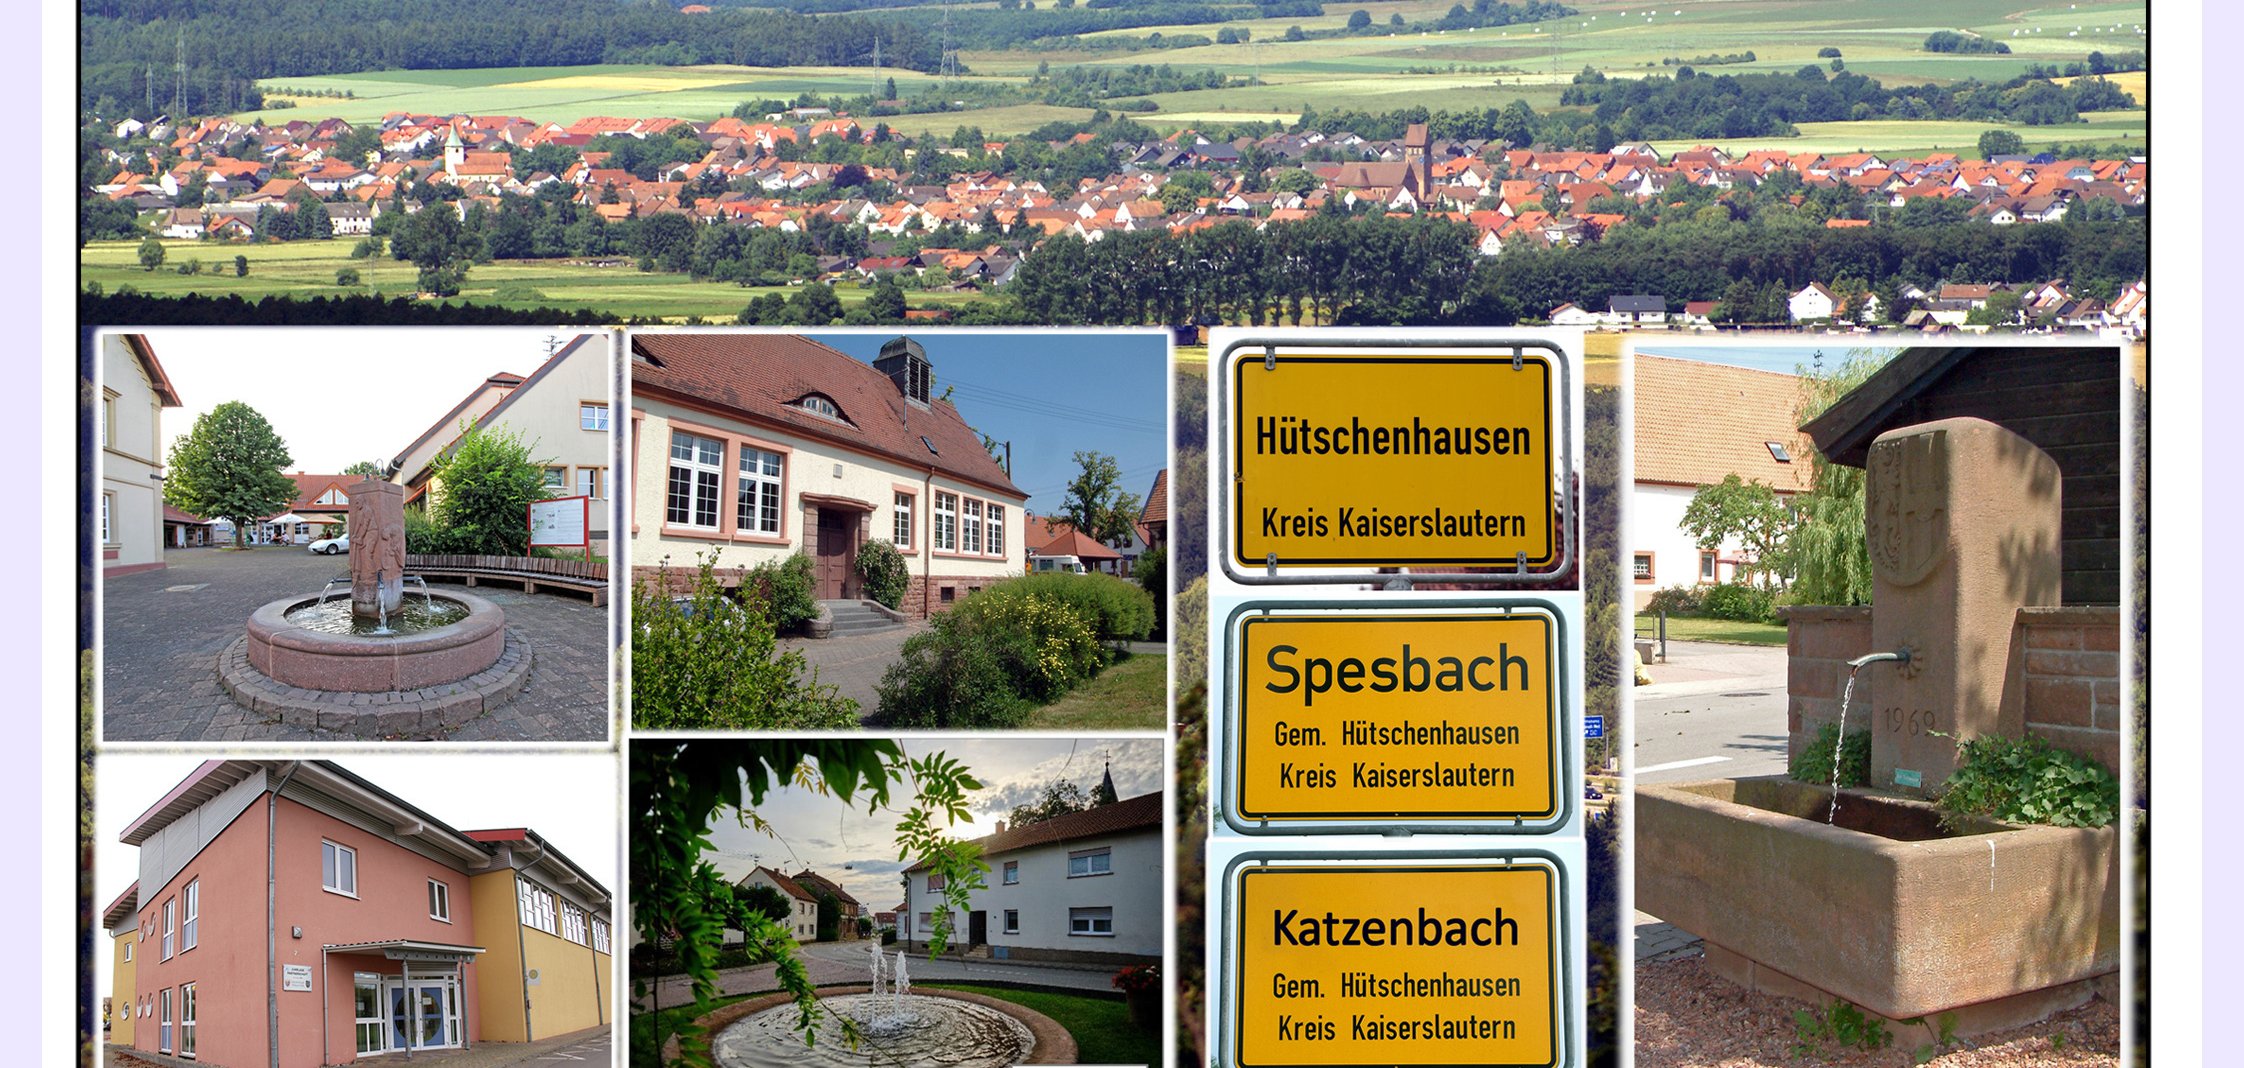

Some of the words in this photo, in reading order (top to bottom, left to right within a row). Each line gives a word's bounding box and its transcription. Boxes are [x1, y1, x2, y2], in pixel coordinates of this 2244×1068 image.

[1256, 416, 1530, 456] Hütschenhausen
[1262, 507, 1329, 538] Kreis
[1339, 507, 1526, 538] Kaiserslautern
[1265, 642, 1529, 707] Spesbach
[1274, 720, 1326, 747] Gem.
[1342, 719, 1520, 746] Hütschenhausen
[1884, 707, 1936, 737] 1969
[1280, 762, 1337, 789] Kreis
[1353, 761, 1514, 788] Kaiserslautern
[1274, 907, 1518, 947] Katzenbach
[1273, 972, 1325, 999] Gem.
[1341, 971, 1521, 998] Hütschenhausen
[1278, 1014, 1336, 1041] Kreis
[1352, 1013, 1516, 1041] Kaiserslautern
